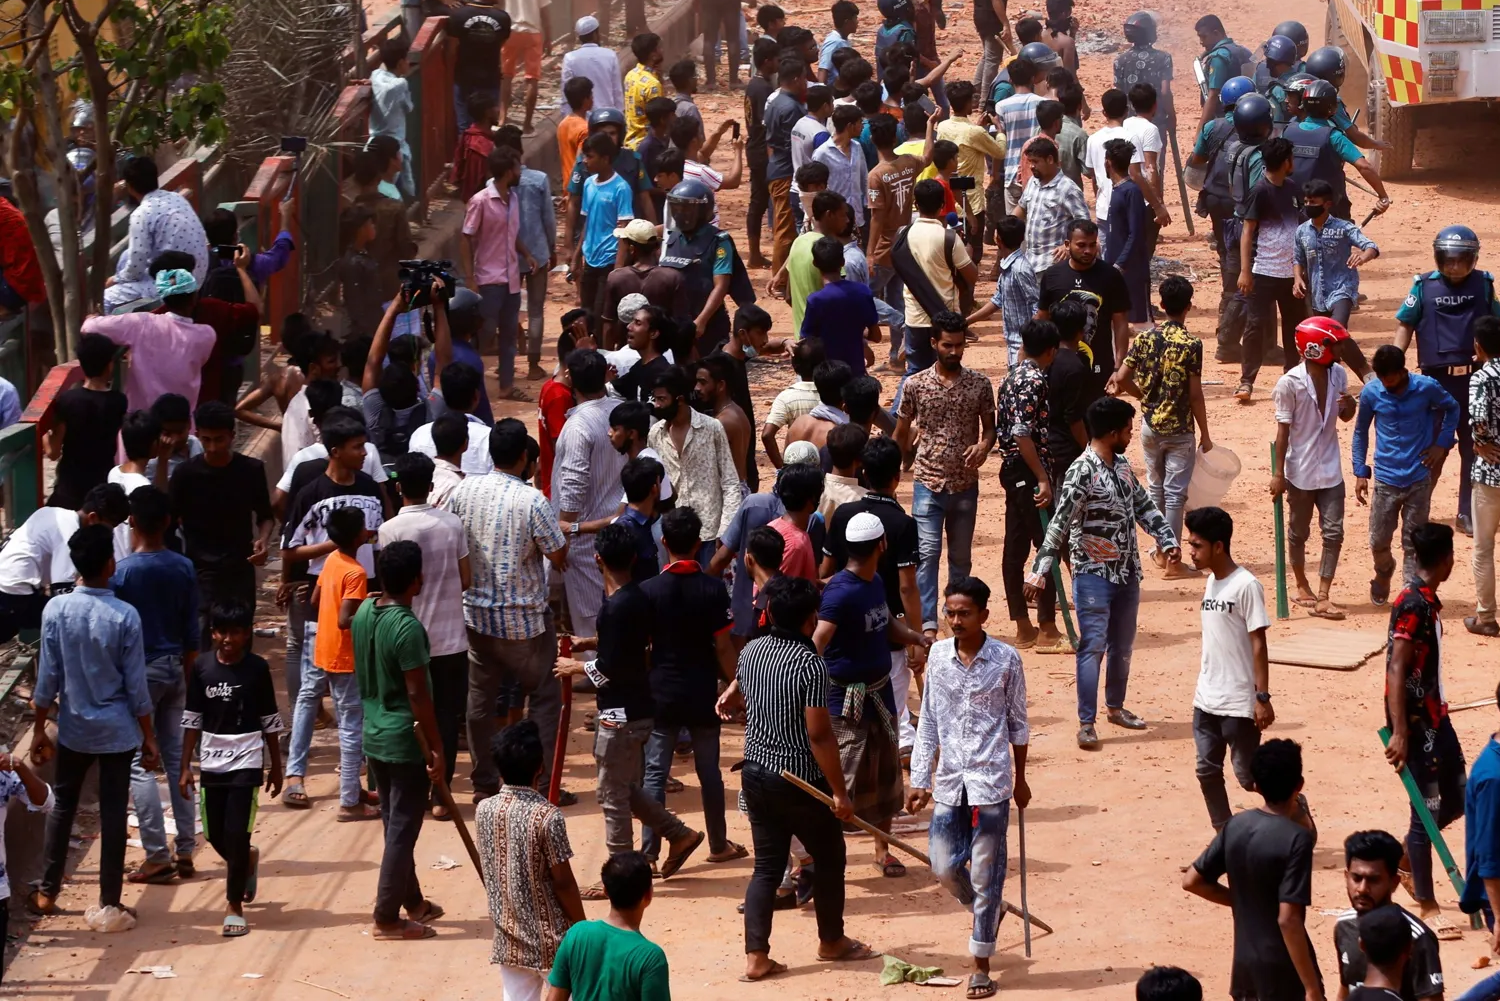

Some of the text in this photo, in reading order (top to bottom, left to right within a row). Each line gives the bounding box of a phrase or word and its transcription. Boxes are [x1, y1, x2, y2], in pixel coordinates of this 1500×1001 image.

[893, 0, 907, 10] POLICE
[661, 256, 690, 265] POLICE
[1435, 294, 1475, 307] POLICE
